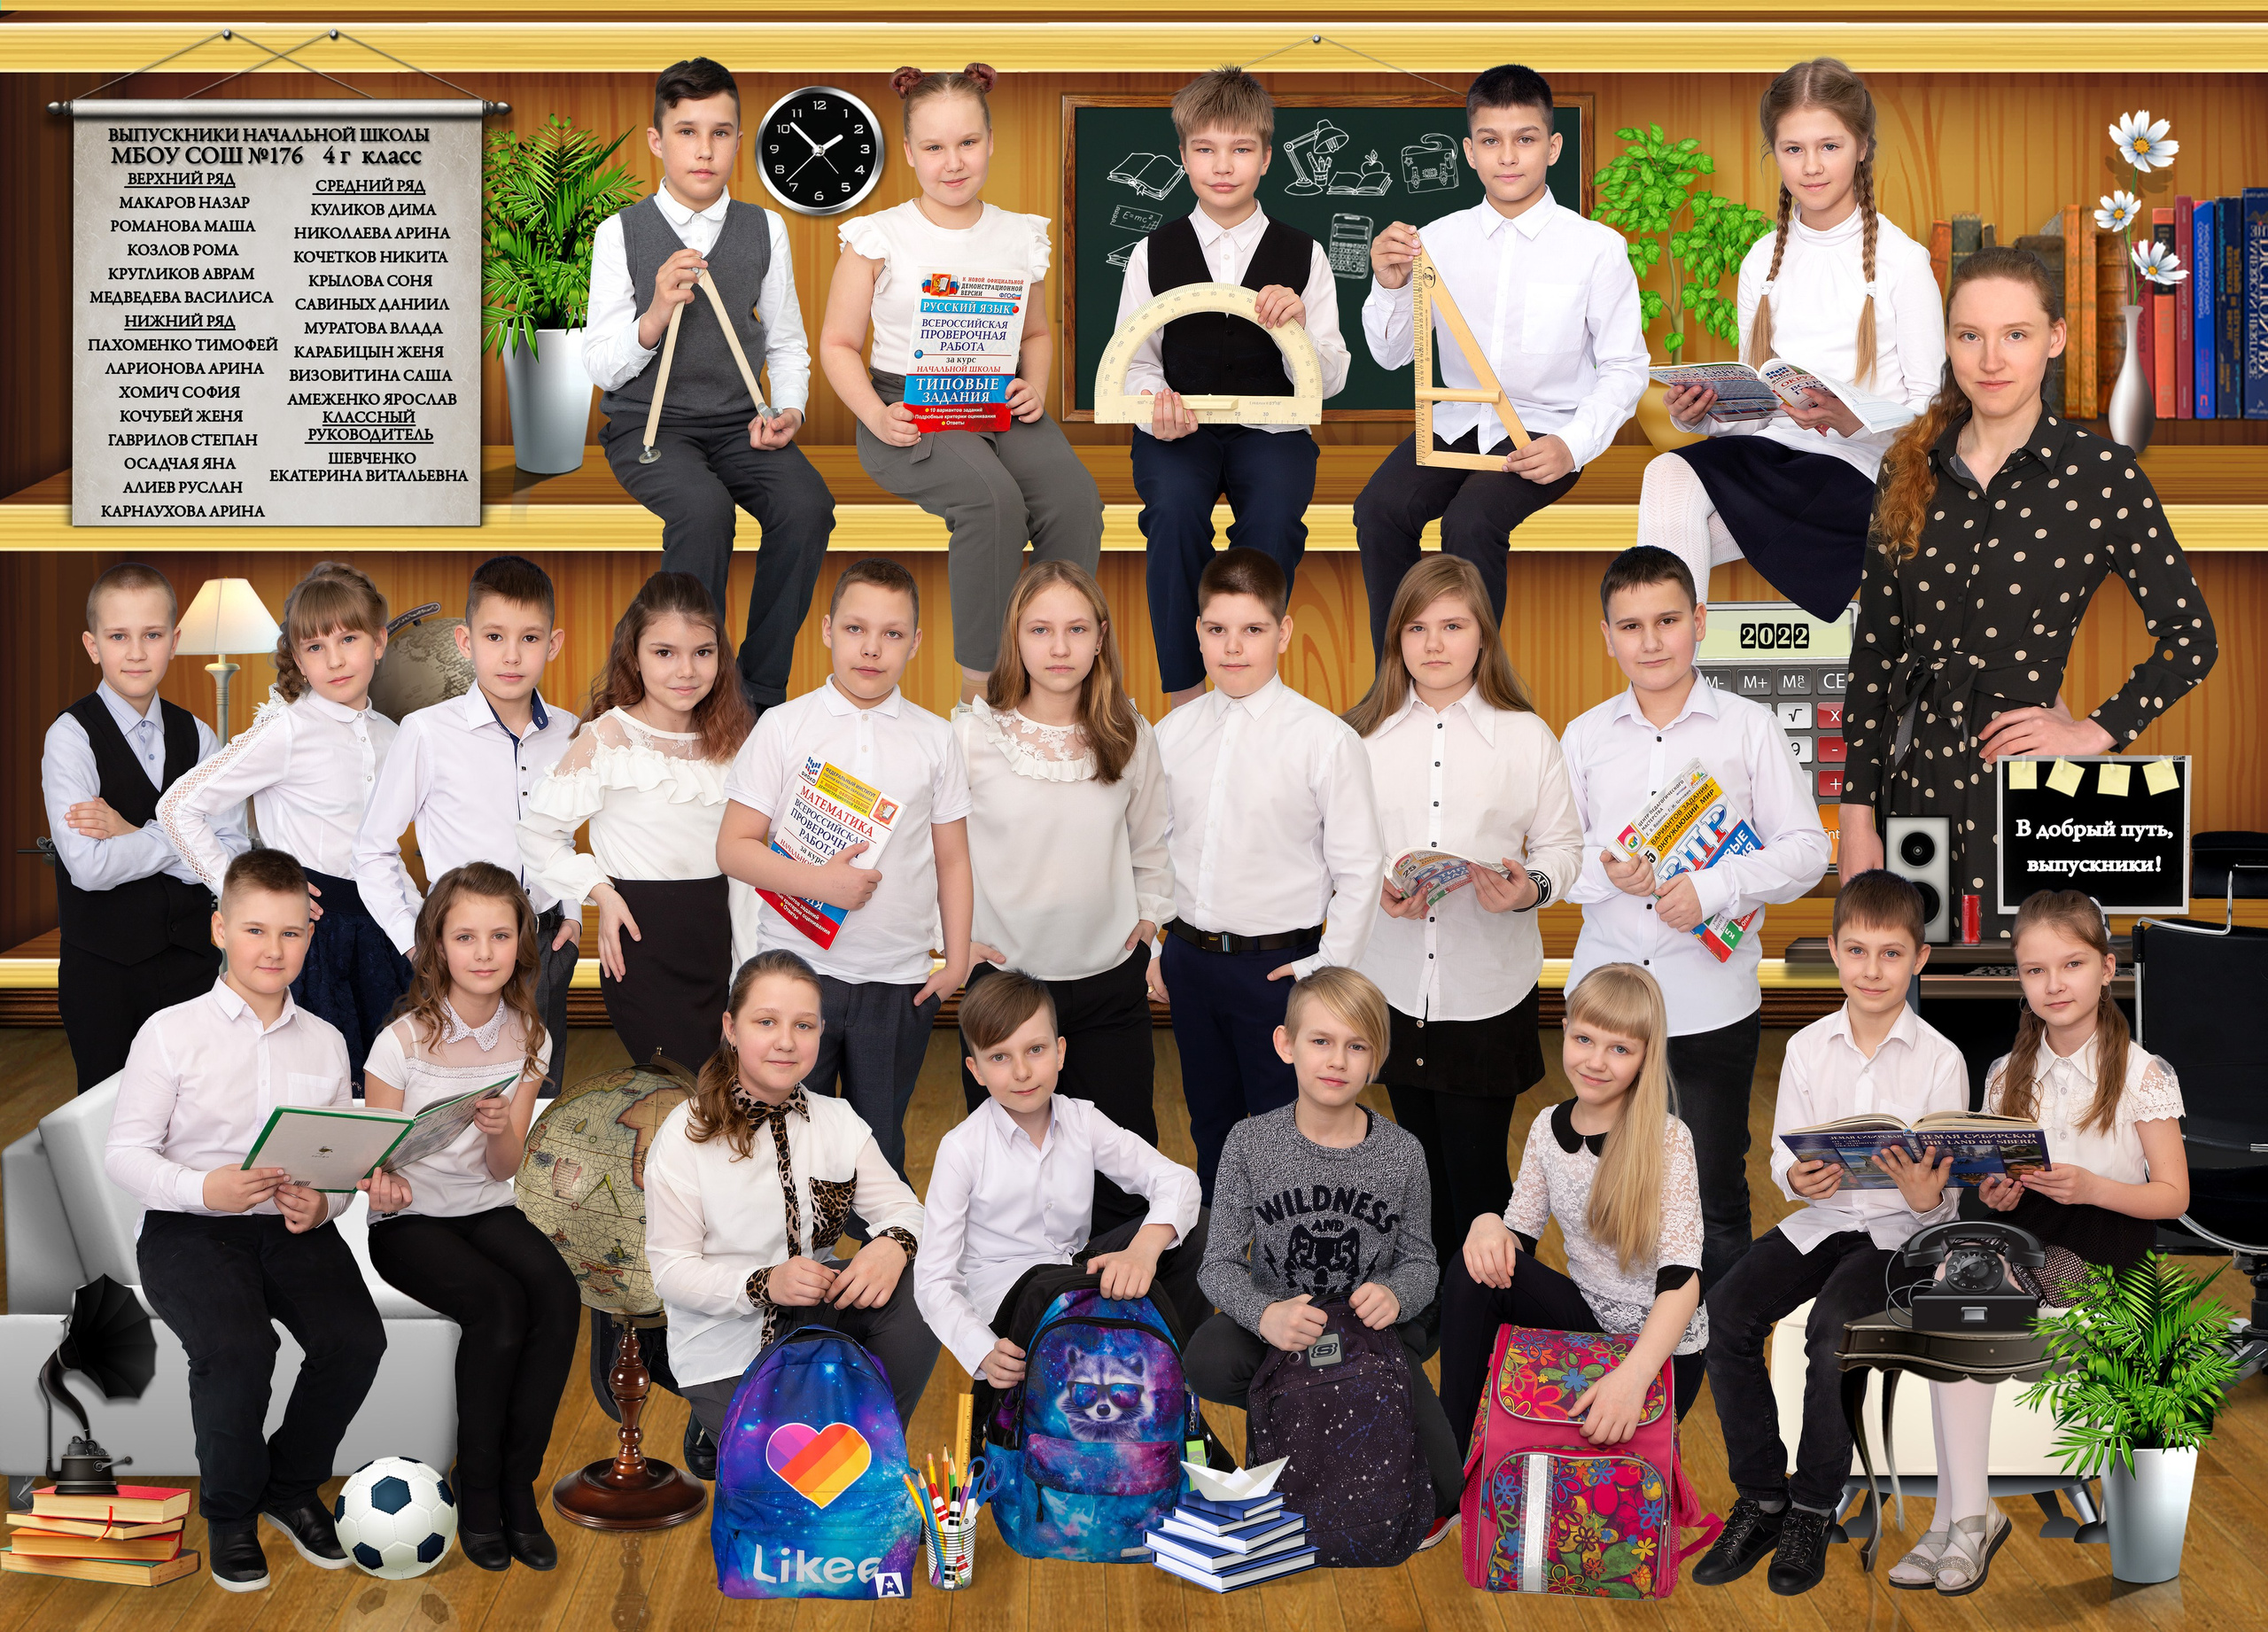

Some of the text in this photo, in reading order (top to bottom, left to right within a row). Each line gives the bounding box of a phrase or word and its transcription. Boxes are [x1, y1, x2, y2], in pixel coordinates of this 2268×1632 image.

[812, 100, 827, 111] 12
[791, 108, 803, 119] 11
[843, 108, 849, 119] 1
[107, 126, 431, 143] ВЫПУСКНИКИ НАЧАЛЬНОЙ ШКОЛЫ
[776, 124, 790, 134] 10
[854, 124, 864, 134] 2
[110, 144, 422, 165] МБОУ СОШ №176 4 г класс
[769, 144, 780, 154] 9
[860, 144, 870, 154] 3
[774, 165, 785, 175] 8
[854, 165, 866, 175] 4
[127, 170, 236, 187] ВЕРХНИЙ РЯД
[315, 177, 426, 194] СРЕДНИЙ РЯД
[788, 183, 799, 192] 7
[841, 183, 851, 192] 5
[119, 196, 251, 209] МАКАРОВ НАЗАР
[814, 190, 824, 201] 6
[310, 203, 437, 218] КУЛИКОВ ДИМА
[110, 220, 257, 232] РОМАНОВА МАША
[293, 227, 452, 239] НИКОЛАЕВА АРИНА
[127, 244, 240, 256] КОЗЛОВ РОМА
[293, 250, 449, 263] КОЧЕТКОВ НИКИТА
[107, 268, 255, 281] КРУГЛИКОВ АВРАМ
[308, 274, 433, 287] КРЫЛОВА СОНЯ
[960, 283, 1023, 292] ДЕМОНСТРАЦИОННОЙ
[89, 291, 275, 306] МЕДВЕДЕВА ВАСИЛИСА
[295, 298, 450, 313] САВИНЫХ ДАНИИЛ
[922, 301, 1011, 315] РУССКИЙ ЯЗЫК
[124, 312, 236, 330] НИЖНИЙ РЯД
[921, 318, 1008, 330] ВСЕРОССИЙСКАЯ
[304, 321, 444, 337] МУРАТОВА ВЛАДА
[920, 329, 1006, 341] ПРОВЕРОЧНАЯ
[88, 336, 278, 352] ПАХОМЕНКО ТИМОФЕЙ
[939, 341, 985, 352] РАБОТА
[293, 346, 445, 361] КАРАБИЦЫН ЖЕНЯ
[956, 356, 976, 365] курс
[105, 361, 265, 375] ЛАРИОНОВА АРИНА
[289, 369, 454, 382] ВИЗОВИТИНА САША
[915, 377, 999, 391] ТИПОВЫЕ
[118, 385, 241, 399] ХОМИЧ СОФИЯ
[286, 392, 457, 406] АМЕЖЕНКО ЯРОСЛАВ
[921, 392, 990, 405] ЗАДАНИЯ
[120, 408, 244, 423] КОЧУБЕЙ ЖЕНЯ
[322, 408, 416, 424] КЛАССНЫЙ
[108, 433, 258, 447] ГАВРИЛОВ СТЕПАН
[307, 427, 434, 443] РУКОВОДИТЕЛЬ
[124, 457, 237, 472] ОСАДЧАЯ ЯНА
[328, 452, 416, 464] ШЕВЧЕНКО
[269, 469, 470, 482] ЕКАТЕРИНА ВИТАЛЬЕВНА
[122, 481, 244, 494] АЛИЕВ РУСЛАН
[100, 505, 266, 518] КАРНАУХОВА АРИНА
[1741, 624, 1809, 648] 2022
[1744, 676, 1768, 688] M+
[1823, 673, 1845, 689] CE
[826, 767, 876, 797] ФЕДЕРАЛЬНЫЙ ИНСТИТУТ
[1637, 779, 1684, 828] ЦЕНТР ПЕДАГОГИЧЕСКОГО
[800, 785, 874, 837] МАТЕМАТИКА
[1651, 783, 1710, 845] ВАРИАНТОВ ЗАДАНИЙ
[1641, 807, 1664, 831] МАСТЕРСТВА
[1657, 789, 1714, 852] ОКРУЖАЮЩИЙ МИР
[2015, 818, 2174, 843] В добрый путь,
[798, 828, 836, 857] РАБОТА
[1657, 804, 1728, 882] ВПР
[800, 845, 825, 866] за курс
[1644, 850, 1657, 864] 5
[1402, 864, 1417, 878] 25
[2026, 855, 2162, 878] выпускники!
[783, 904, 799, 921] Ответы
[800, 904, 819, 921] заданий
[1255, 1185, 1401, 1234] WILDNESS
[1311, 1219, 1345, 1232] AND
[753, 1543, 882, 1584] Likee
